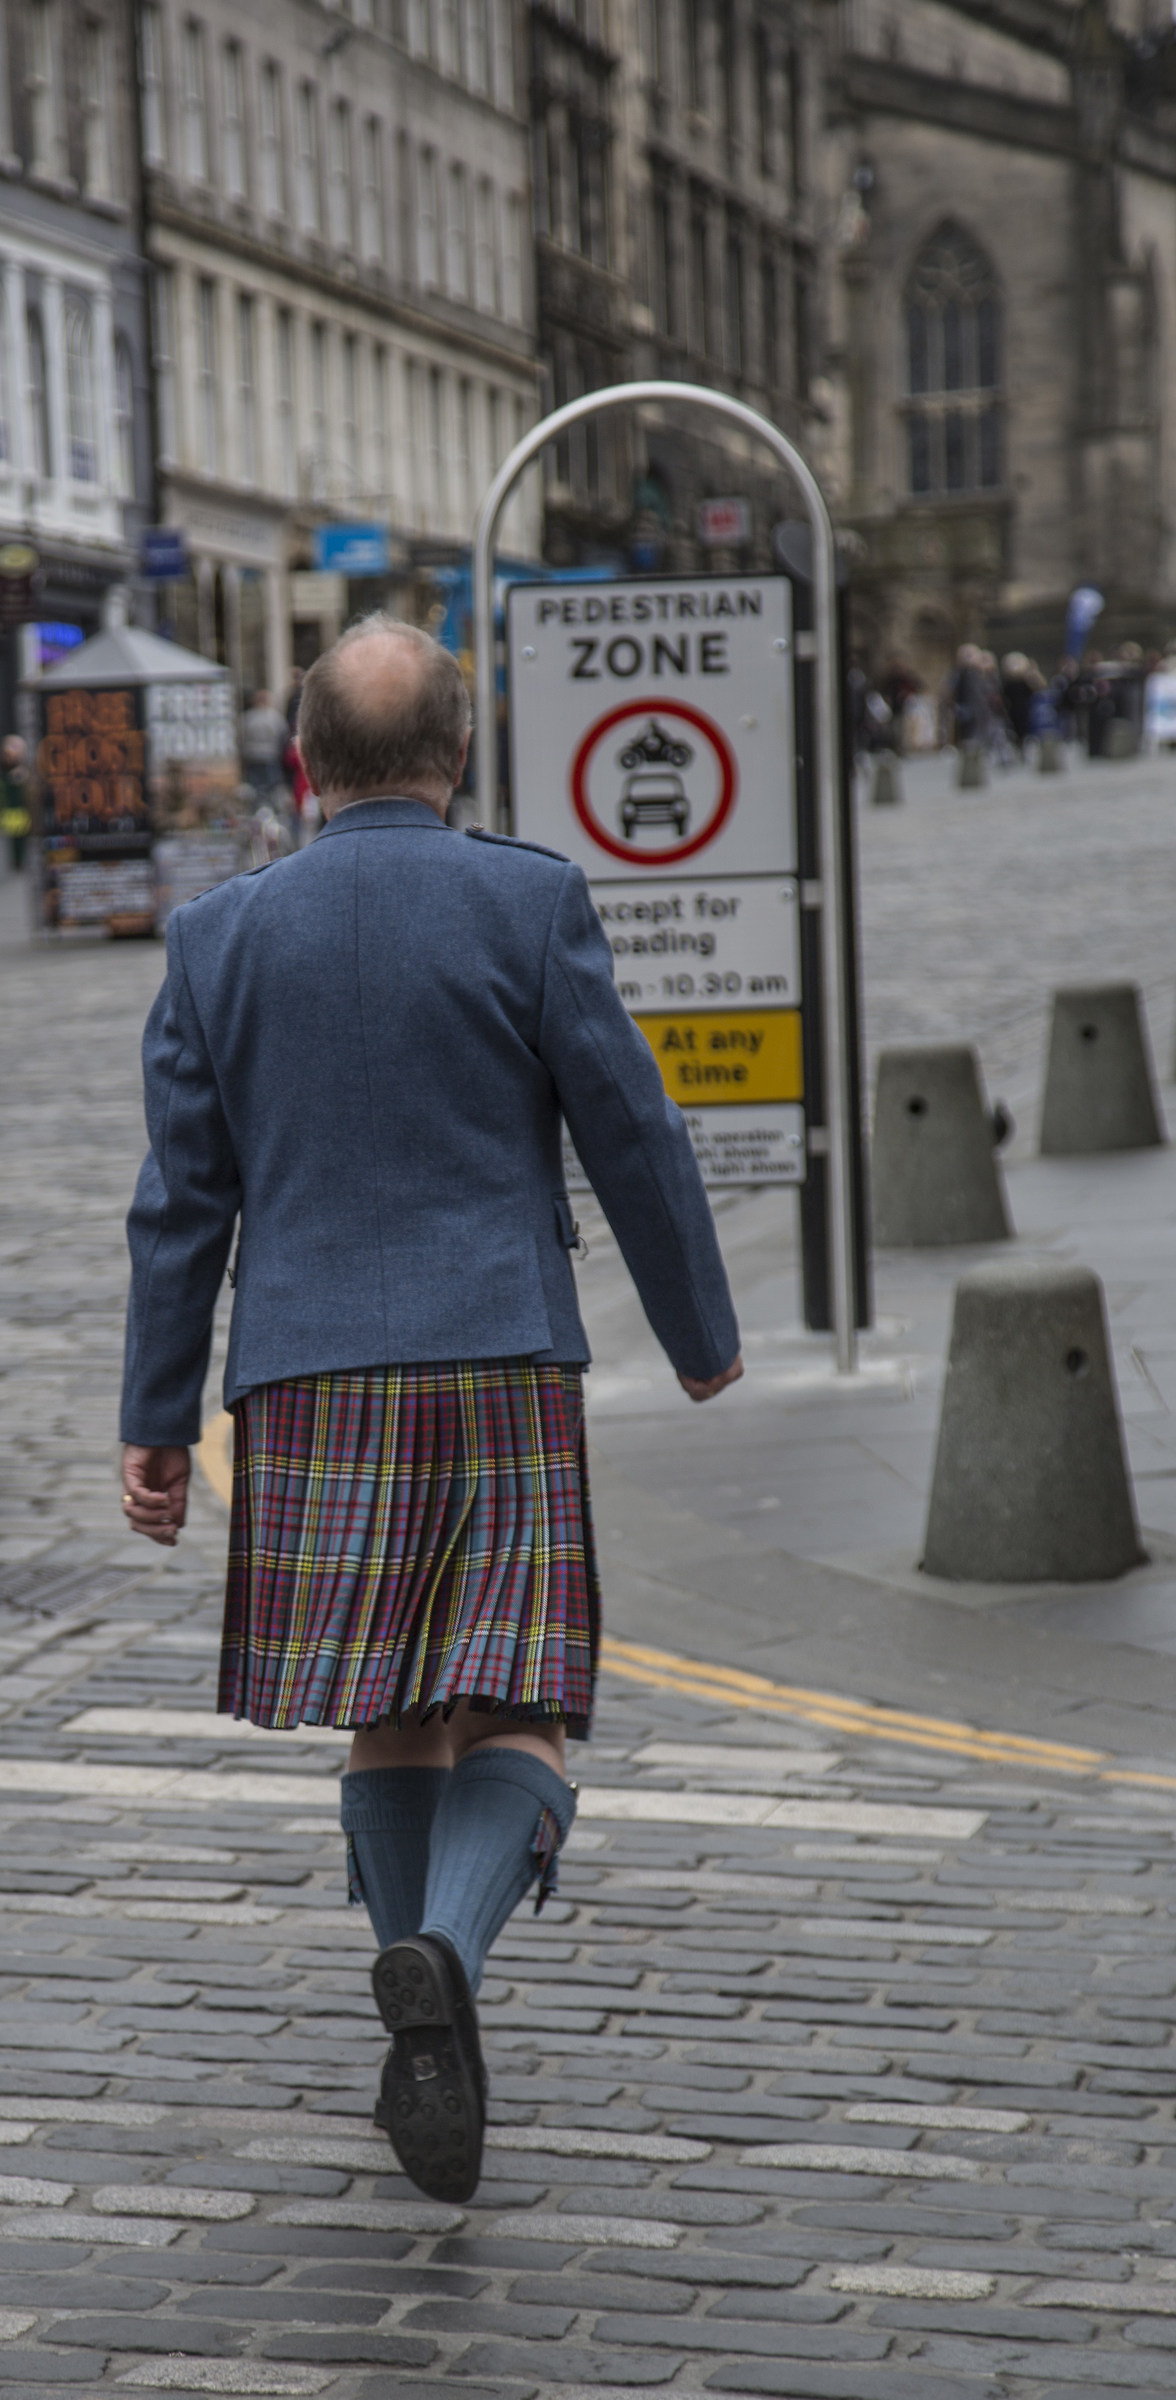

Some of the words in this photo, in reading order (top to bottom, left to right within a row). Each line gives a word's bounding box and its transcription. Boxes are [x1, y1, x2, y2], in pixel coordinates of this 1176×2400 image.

[537, 590, 763, 625] PEDESTRIAN
[571, 632, 729, 679] ZONE
[597, 895, 683, 924] xcept
[694, 892, 741, 920] for
[611, 928, 716, 958] oading
[661, 971, 742, 998] 10.30
[748, 974, 788, 993] am
[661, 1027, 697, 1052] At
[709, 1029, 763, 1057] any
[677, 1060, 748, 1085] time
